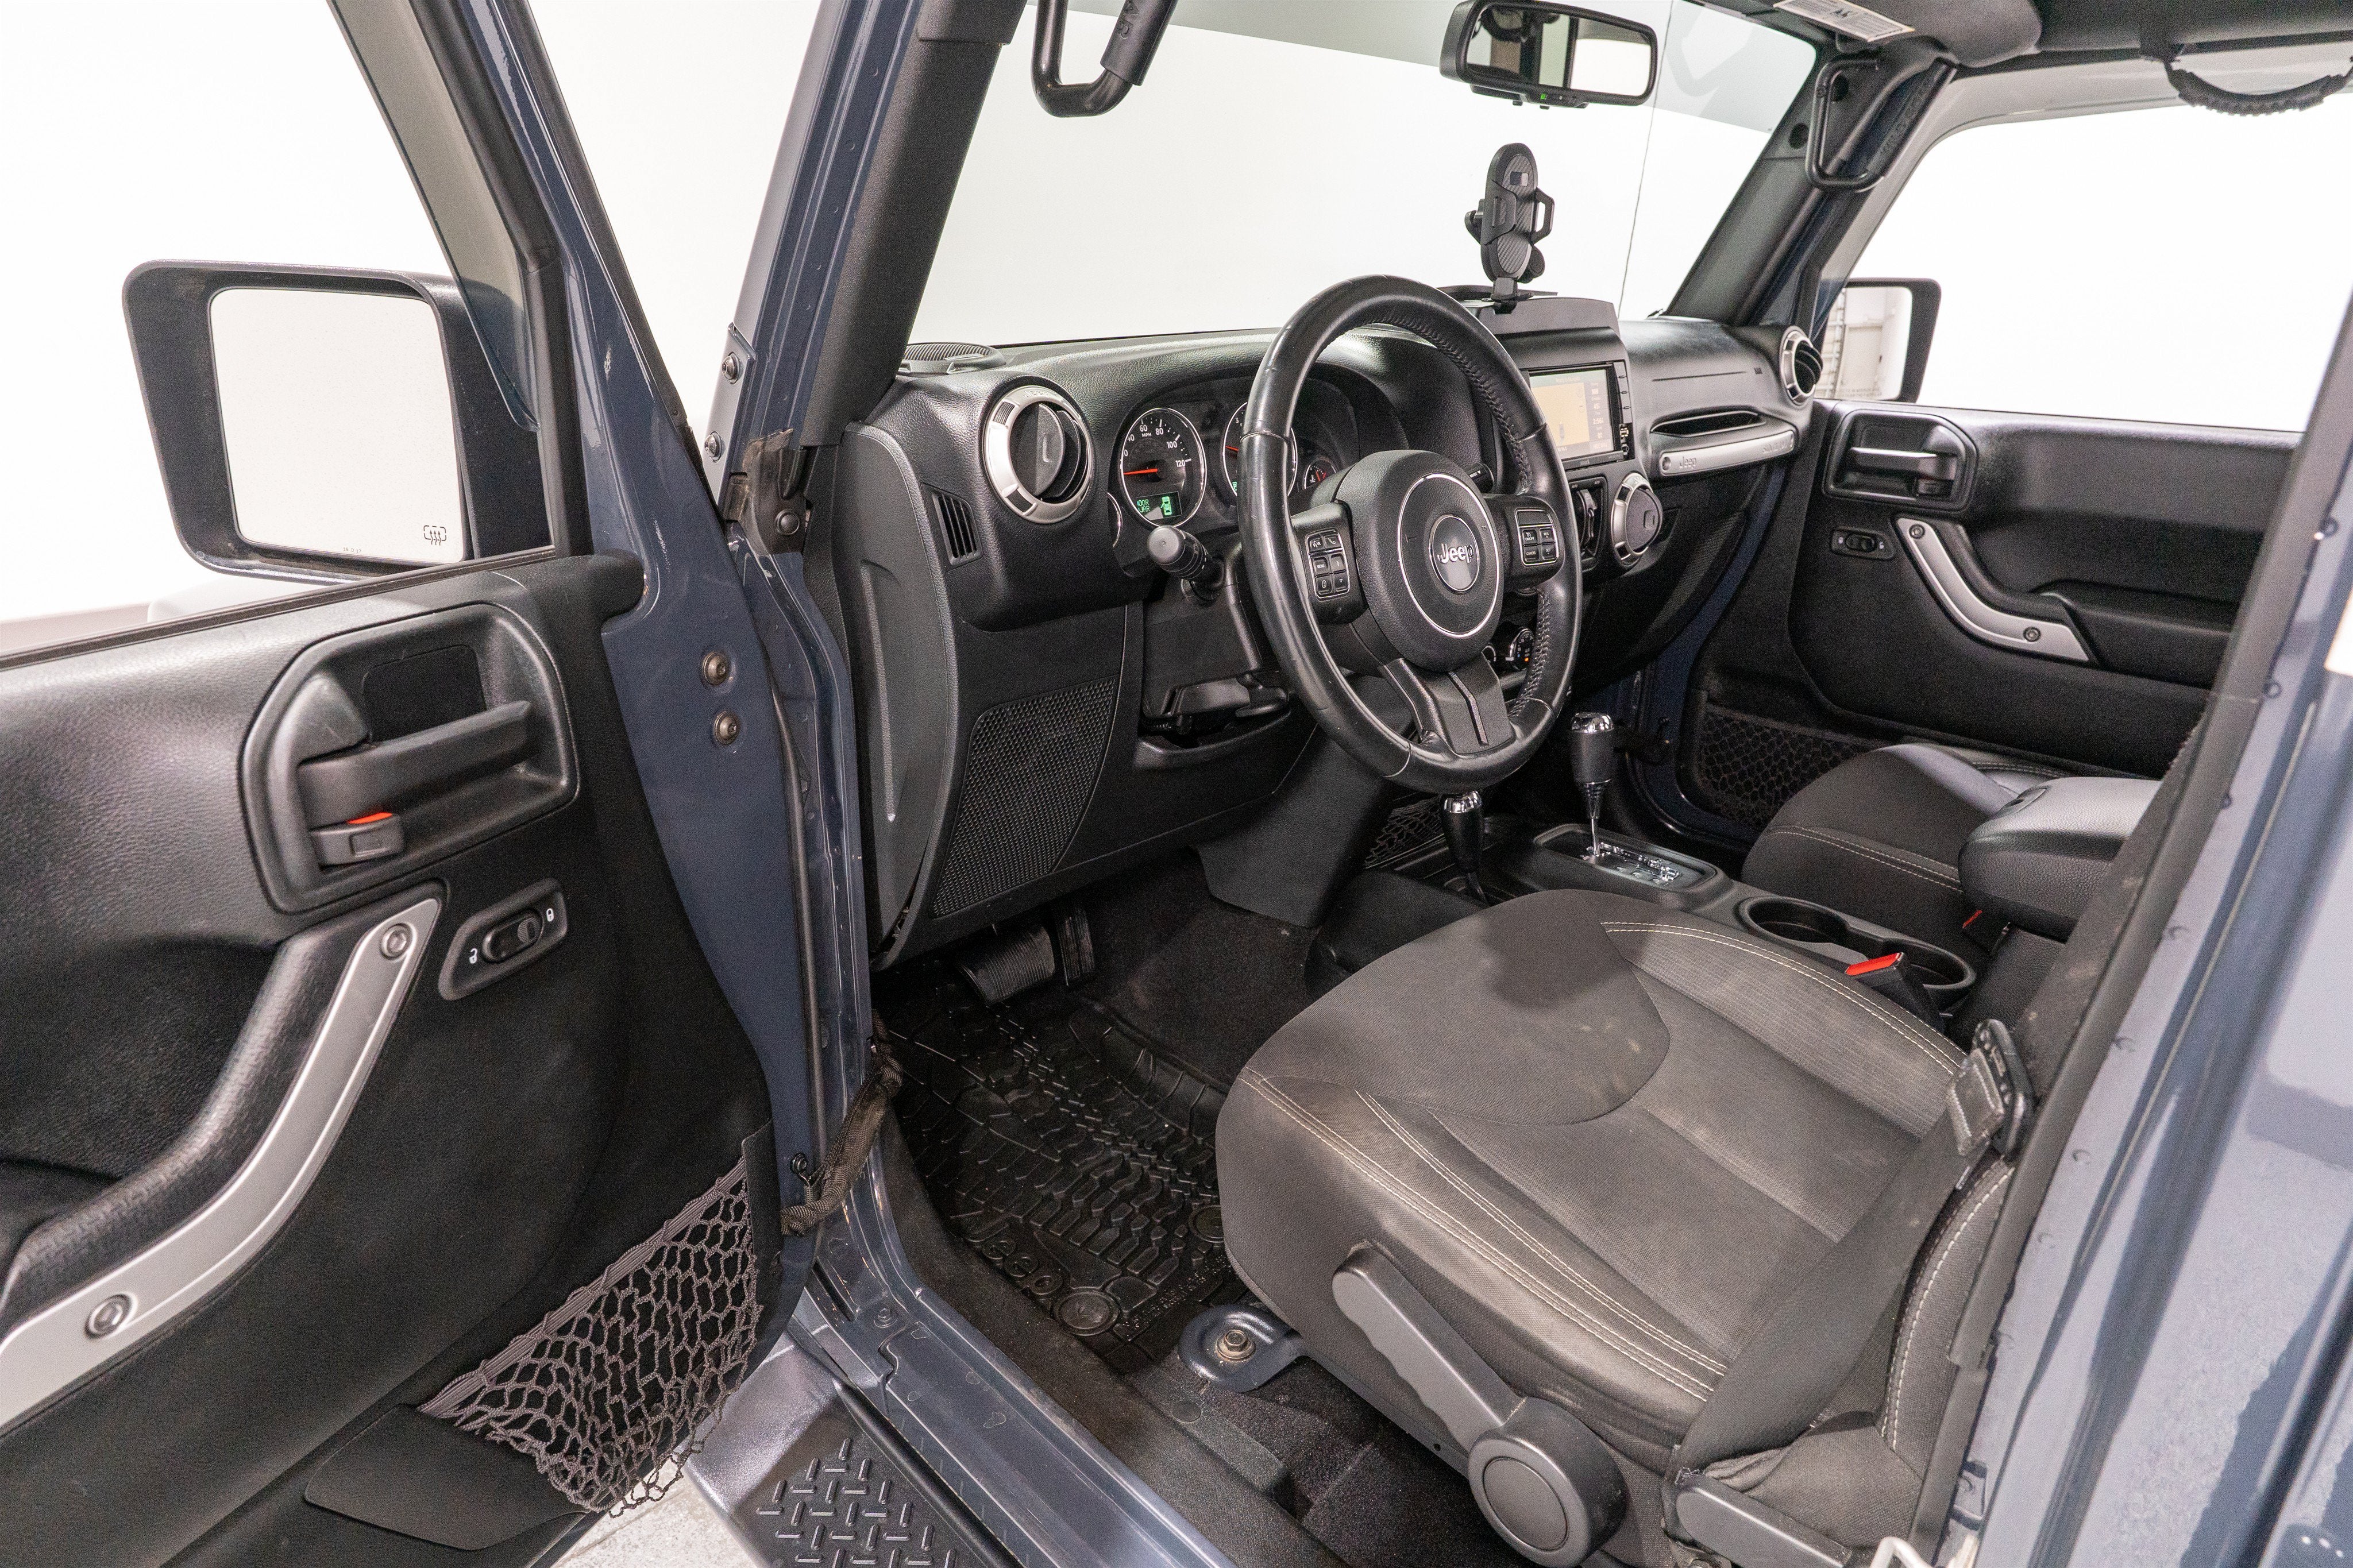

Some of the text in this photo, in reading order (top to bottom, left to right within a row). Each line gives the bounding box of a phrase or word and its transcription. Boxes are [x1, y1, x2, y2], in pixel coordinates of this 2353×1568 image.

[1139, 424, 1148, 432] 60
[1155, 427, 1164, 435] 80
[1166, 441, 1178, 449] 100
[1679, 456, 1697, 470] Jeep
[1437, 543, 1474, 564] Jeep
